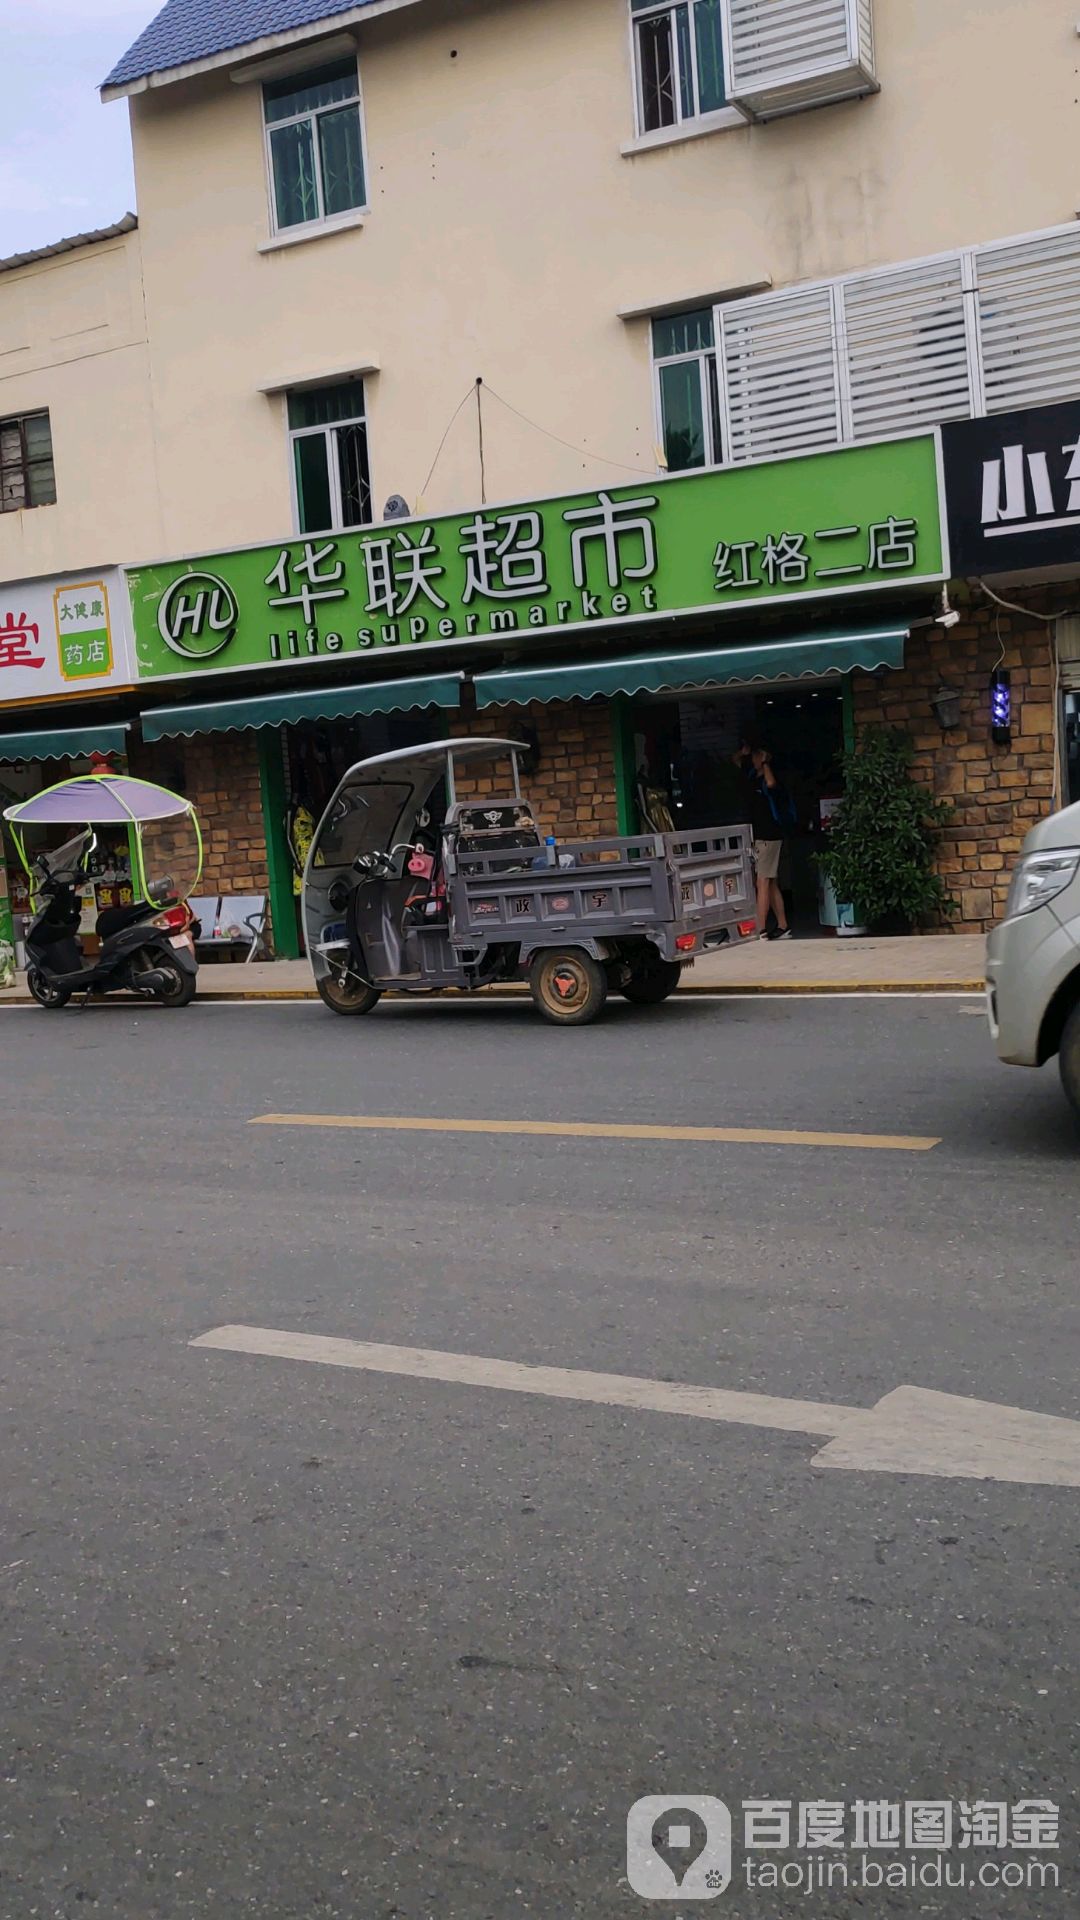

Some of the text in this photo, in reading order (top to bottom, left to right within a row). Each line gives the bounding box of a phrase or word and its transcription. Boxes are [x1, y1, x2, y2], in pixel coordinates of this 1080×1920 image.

[980, 434, 1080, 523] 小
[264, 492, 660, 626] 华联超市
[713, 516, 918, 590] 红格二店
[0, 612, 46, 669] 堂
[60, 600, 104, 621] 大健康
[269, 585, 658, 659] life supermarket
[65, 640, 105, 665] 药店
